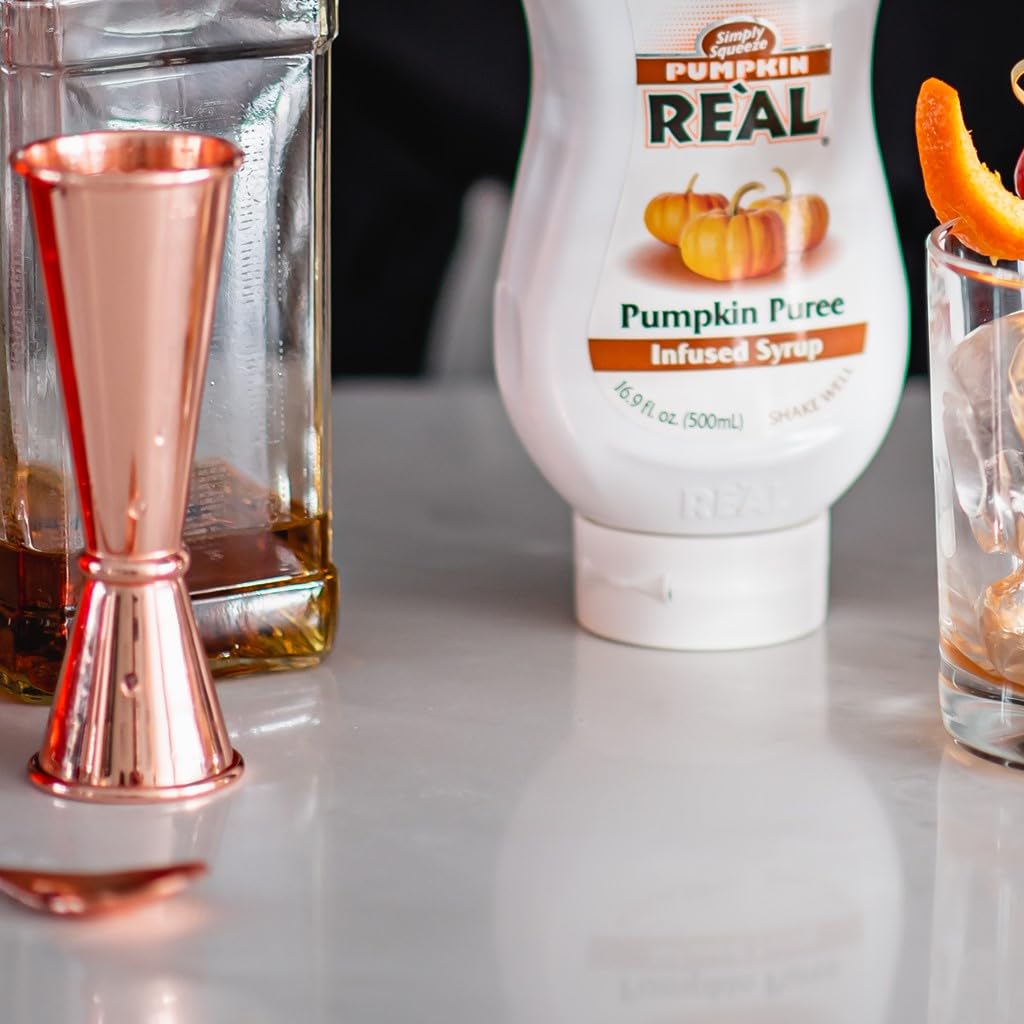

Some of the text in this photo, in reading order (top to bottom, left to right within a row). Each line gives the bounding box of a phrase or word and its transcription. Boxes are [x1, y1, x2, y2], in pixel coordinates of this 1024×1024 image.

[715, 25, 765, 45] Simply
[708, 38, 769, 60] Squeeze
[665, 55, 810, 81] PUMPKIN
[620, 297, 845, 334] Pumpkin Puree
[651, 337, 825, 366] Infused Syrup
[613, 380, 644, 408] 16.9
[682, 411, 744, 431] (500mL)
[768, 398, 820, 425] SHAKE
